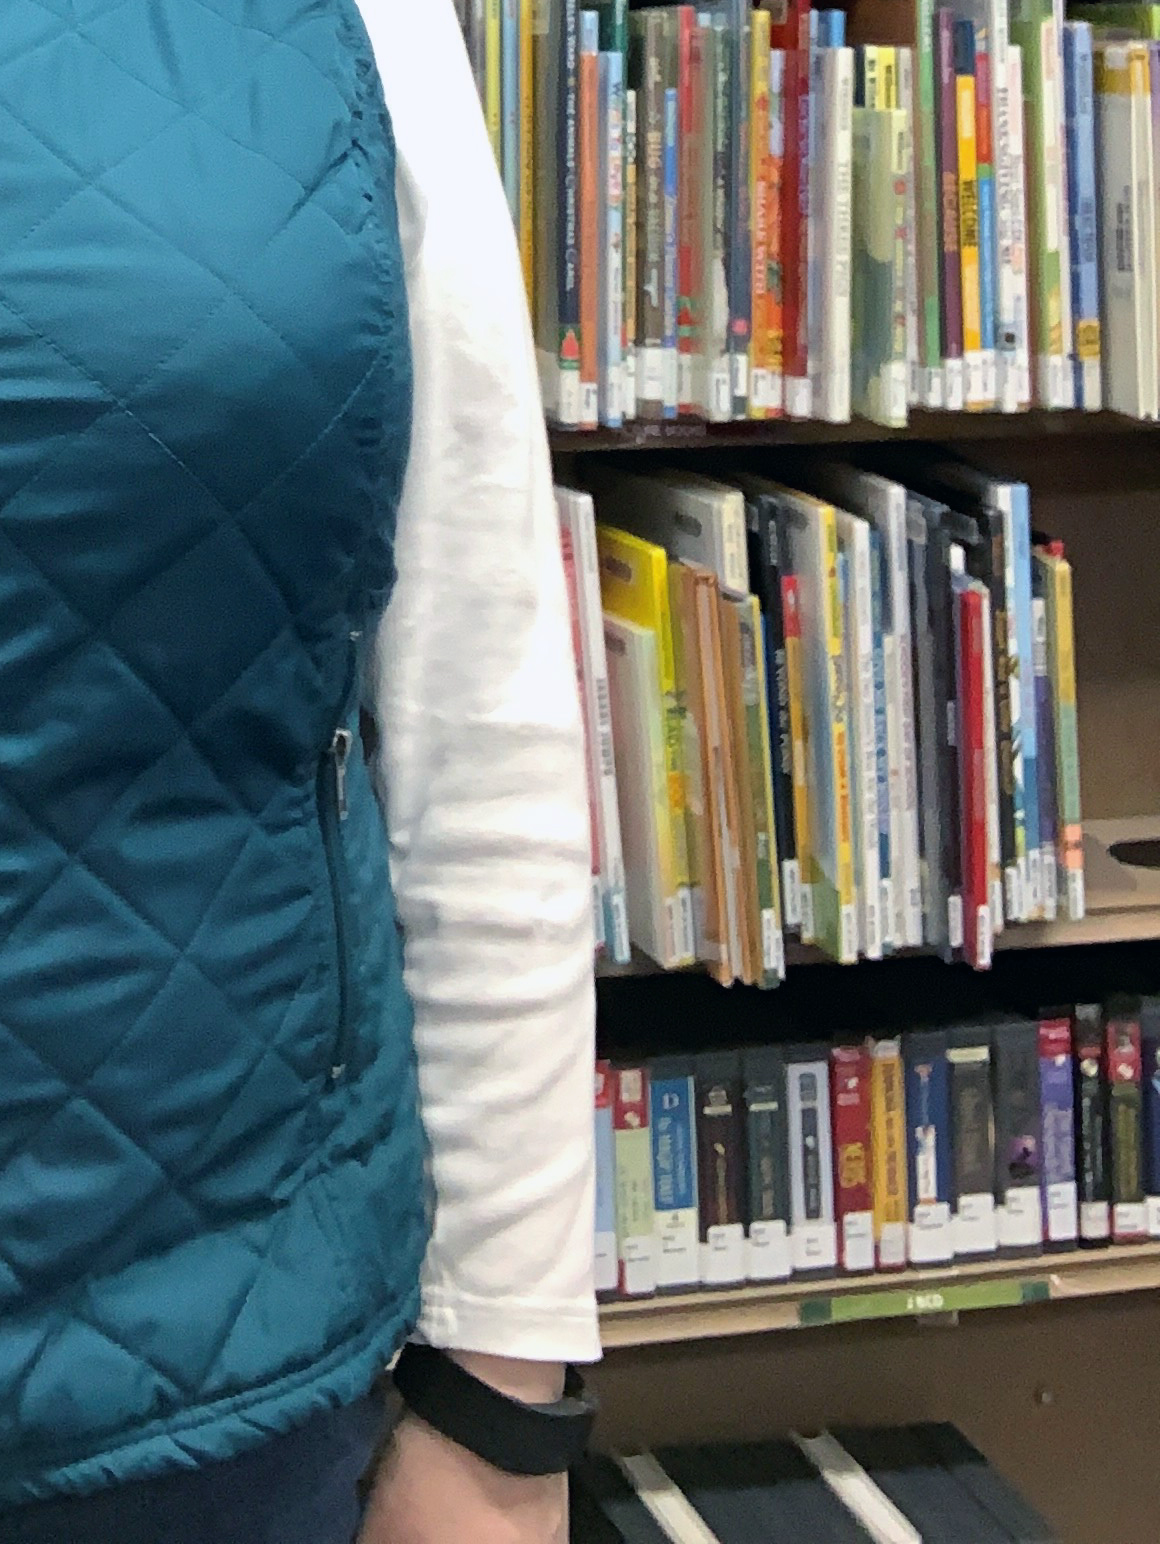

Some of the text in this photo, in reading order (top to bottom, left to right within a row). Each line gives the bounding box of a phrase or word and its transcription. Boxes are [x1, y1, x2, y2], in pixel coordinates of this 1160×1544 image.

[566, 35, 577, 70] WARD
[566, 92, 576, 116] THE
[963, 180, 978, 247] WELCOME
[565, 247, 578, 291] CAROL
